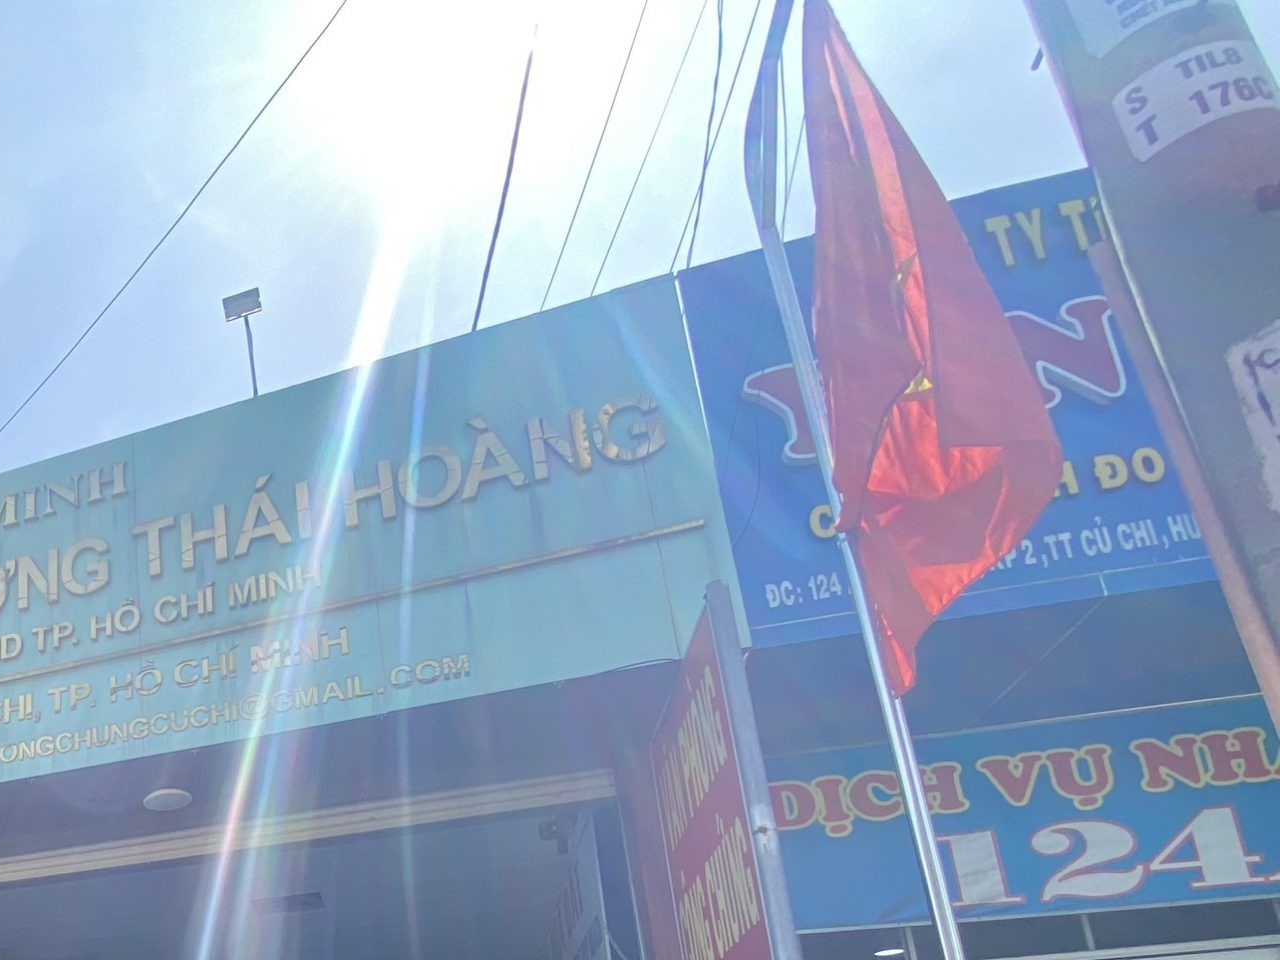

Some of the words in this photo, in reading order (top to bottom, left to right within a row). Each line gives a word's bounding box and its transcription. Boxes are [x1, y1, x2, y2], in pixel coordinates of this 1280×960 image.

[1124, 86, 1148, 115] S
[1136, 114, 1158, 146] T
[985, 207, 1046, 267] TY
[131, 473, 314, 579] THÁI
[343, 394, 668, 530] HOÀNG
[1080, 516, 1112, 556] CỦ
[31, 621, 79, 653] TP.
[89, 598, 142, 641] HỒ
[154, 582, 215, 624] CHÍ
[228, 565, 322, 609] MINH
[109, 659, 163, 703] HỒ
[174, 644, 239, 688] CHÍ
[250, 626, 350, 673] MINH
[677, 664, 728, 818] PHÒNG
[768, 762, 970, 837] DỊCH
[977, 745, 1114, 810] VỤ
[1131, 727, 1280, 792] NH
[705, 813, 760, 959] CHỨNG
